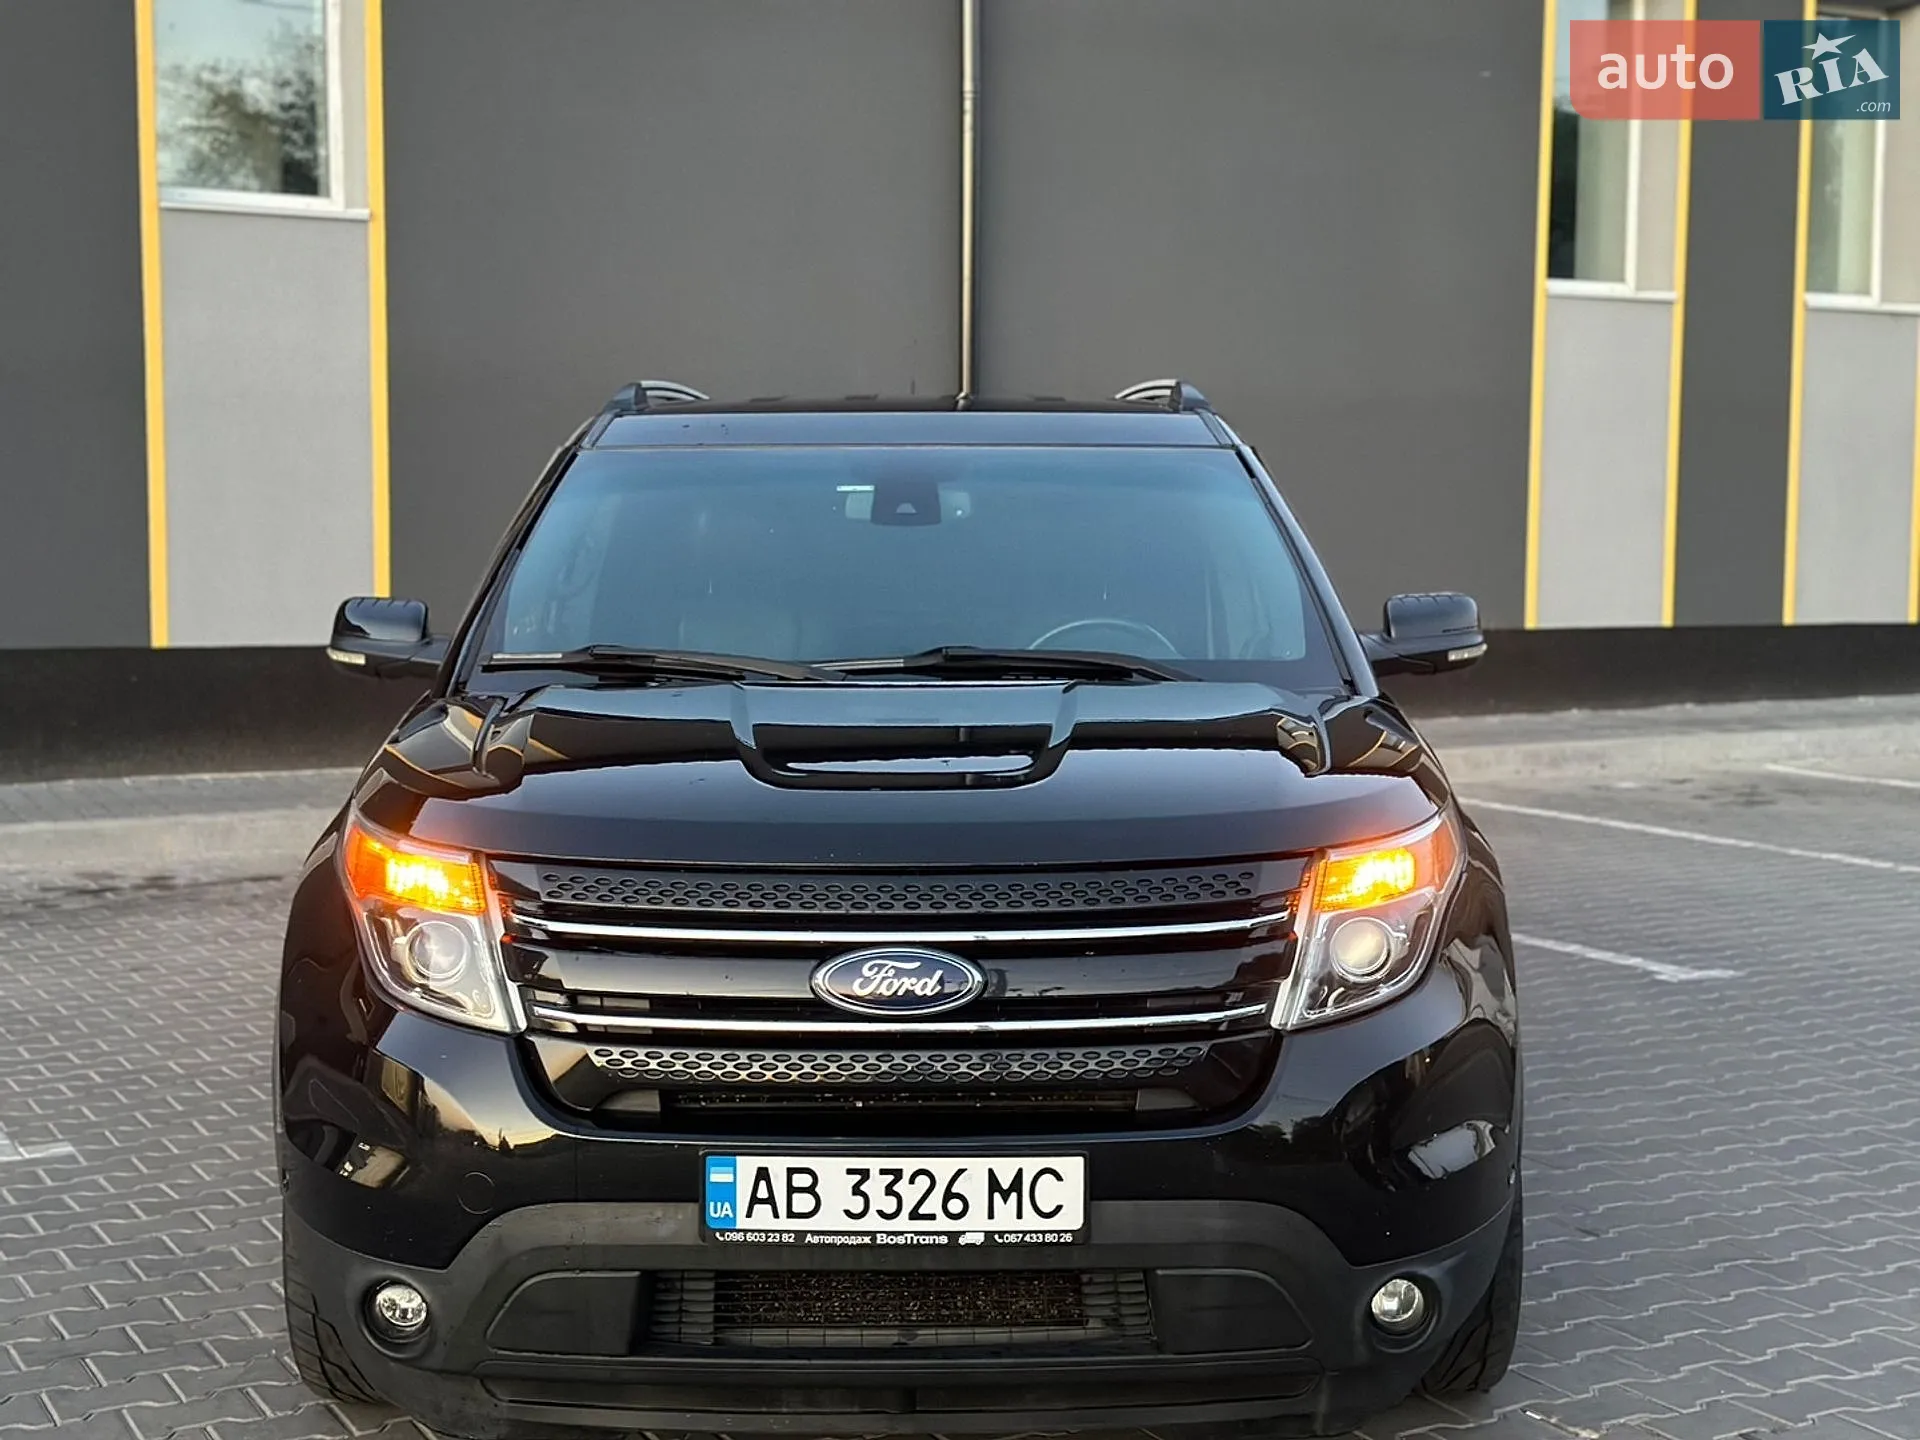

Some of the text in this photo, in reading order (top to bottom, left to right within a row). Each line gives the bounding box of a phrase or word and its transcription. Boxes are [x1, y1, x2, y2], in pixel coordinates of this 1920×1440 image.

[852, 959, 944, 997] Ford
[745, 1166, 1065, 1221] AB 3326 MC
[709, 1201, 734, 1218] UA
[724, 1232, 795, 1243] 096 603 23 82
[804, 1233, 949, 1246] Автопродаж BosTrans
[1023, 1233, 1043, 1243] 433
[1044, 1233, 1059, 1243] 80
[1059, 1233, 1073, 1243] 26
